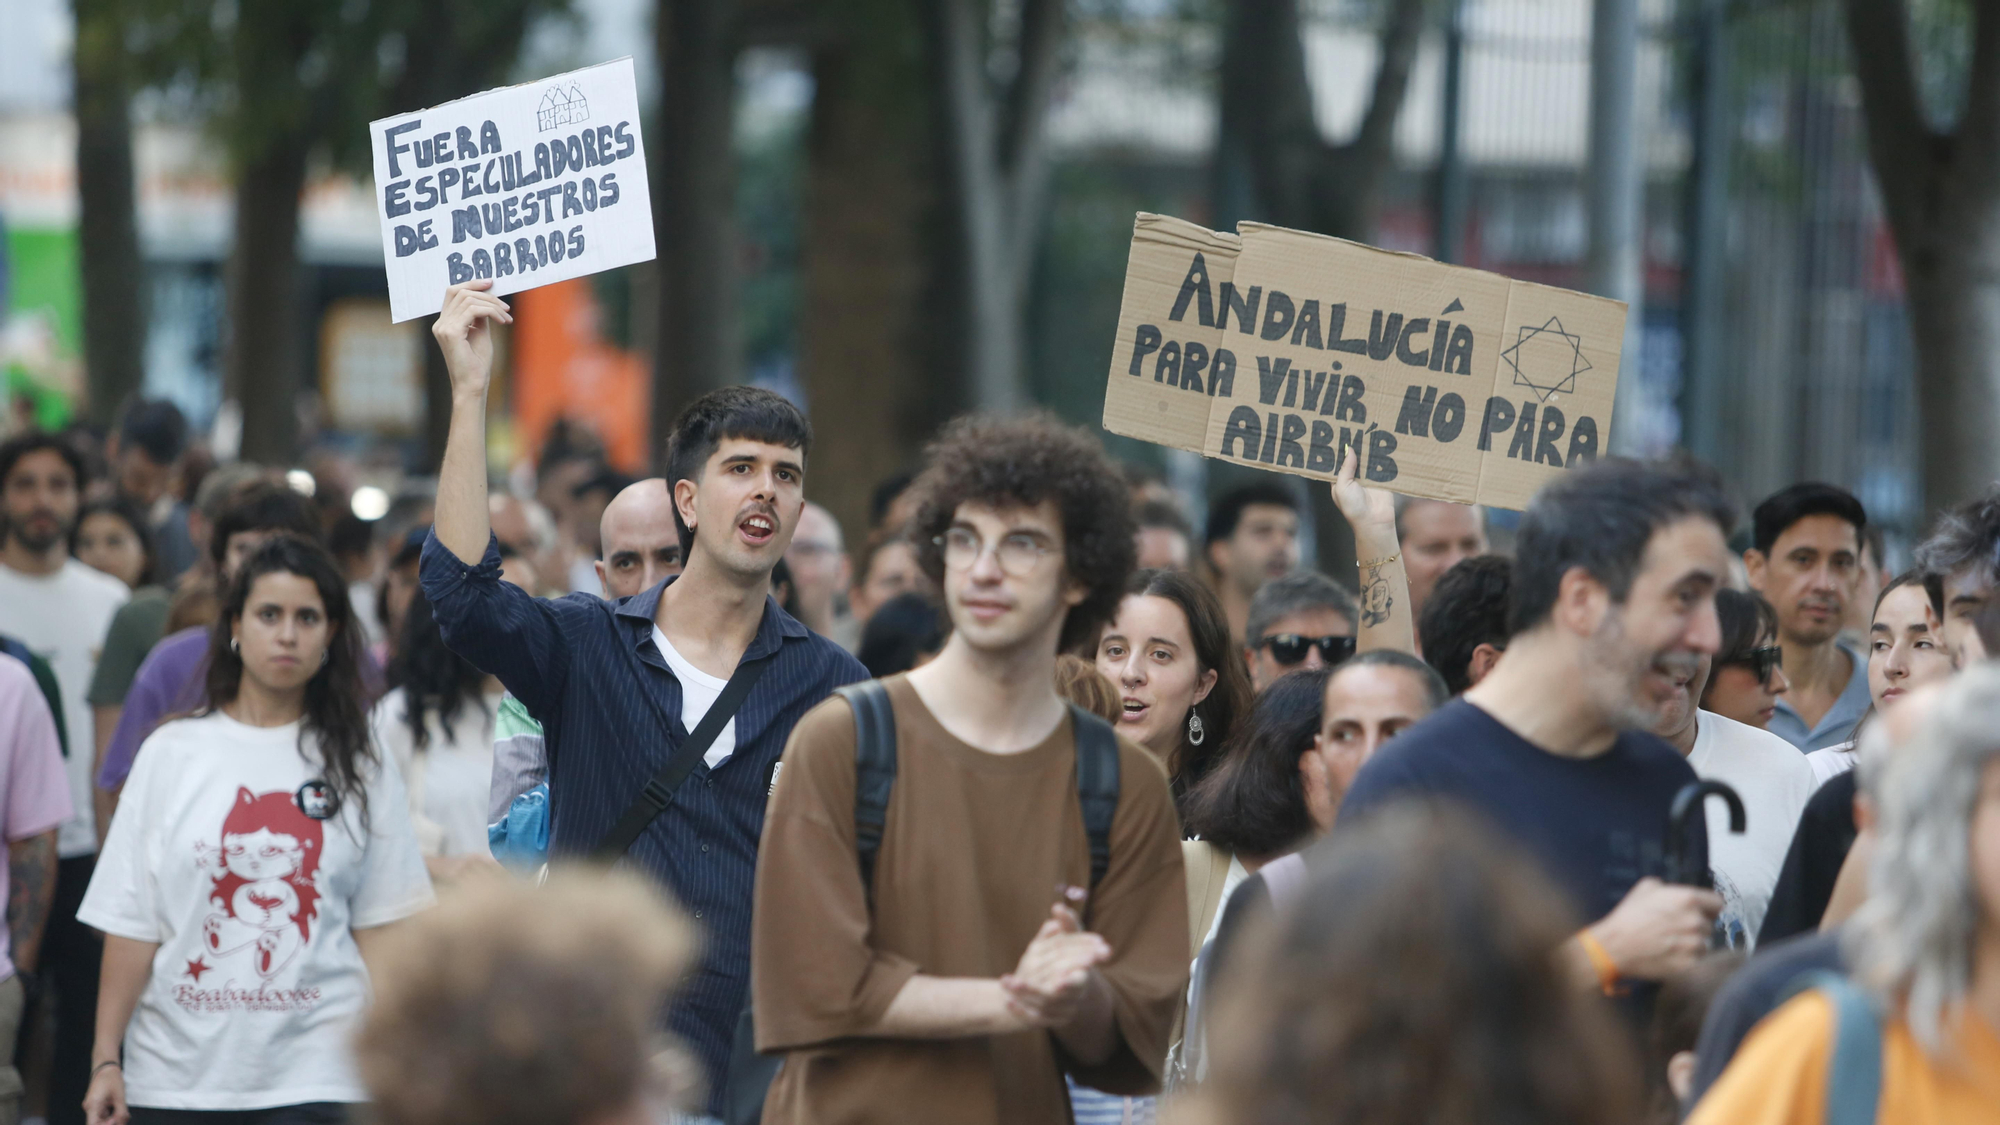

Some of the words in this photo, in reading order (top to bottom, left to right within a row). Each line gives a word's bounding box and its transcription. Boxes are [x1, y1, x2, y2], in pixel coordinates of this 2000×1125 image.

[384, 119, 502, 179] FUERA
[384, 120, 635, 219] ESPECULADORES
[394, 218, 439, 258] DE
[451, 173, 620, 244] NUESTROS
[446, 224, 585, 286] BARRIOS
[1168, 251, 1474, 376] ANDALUCÍA
[1129, 324, 1237, 398] PARA
[1394, 385, 1466, 444] NO
[1476, 395, 1599, 469] PARA
